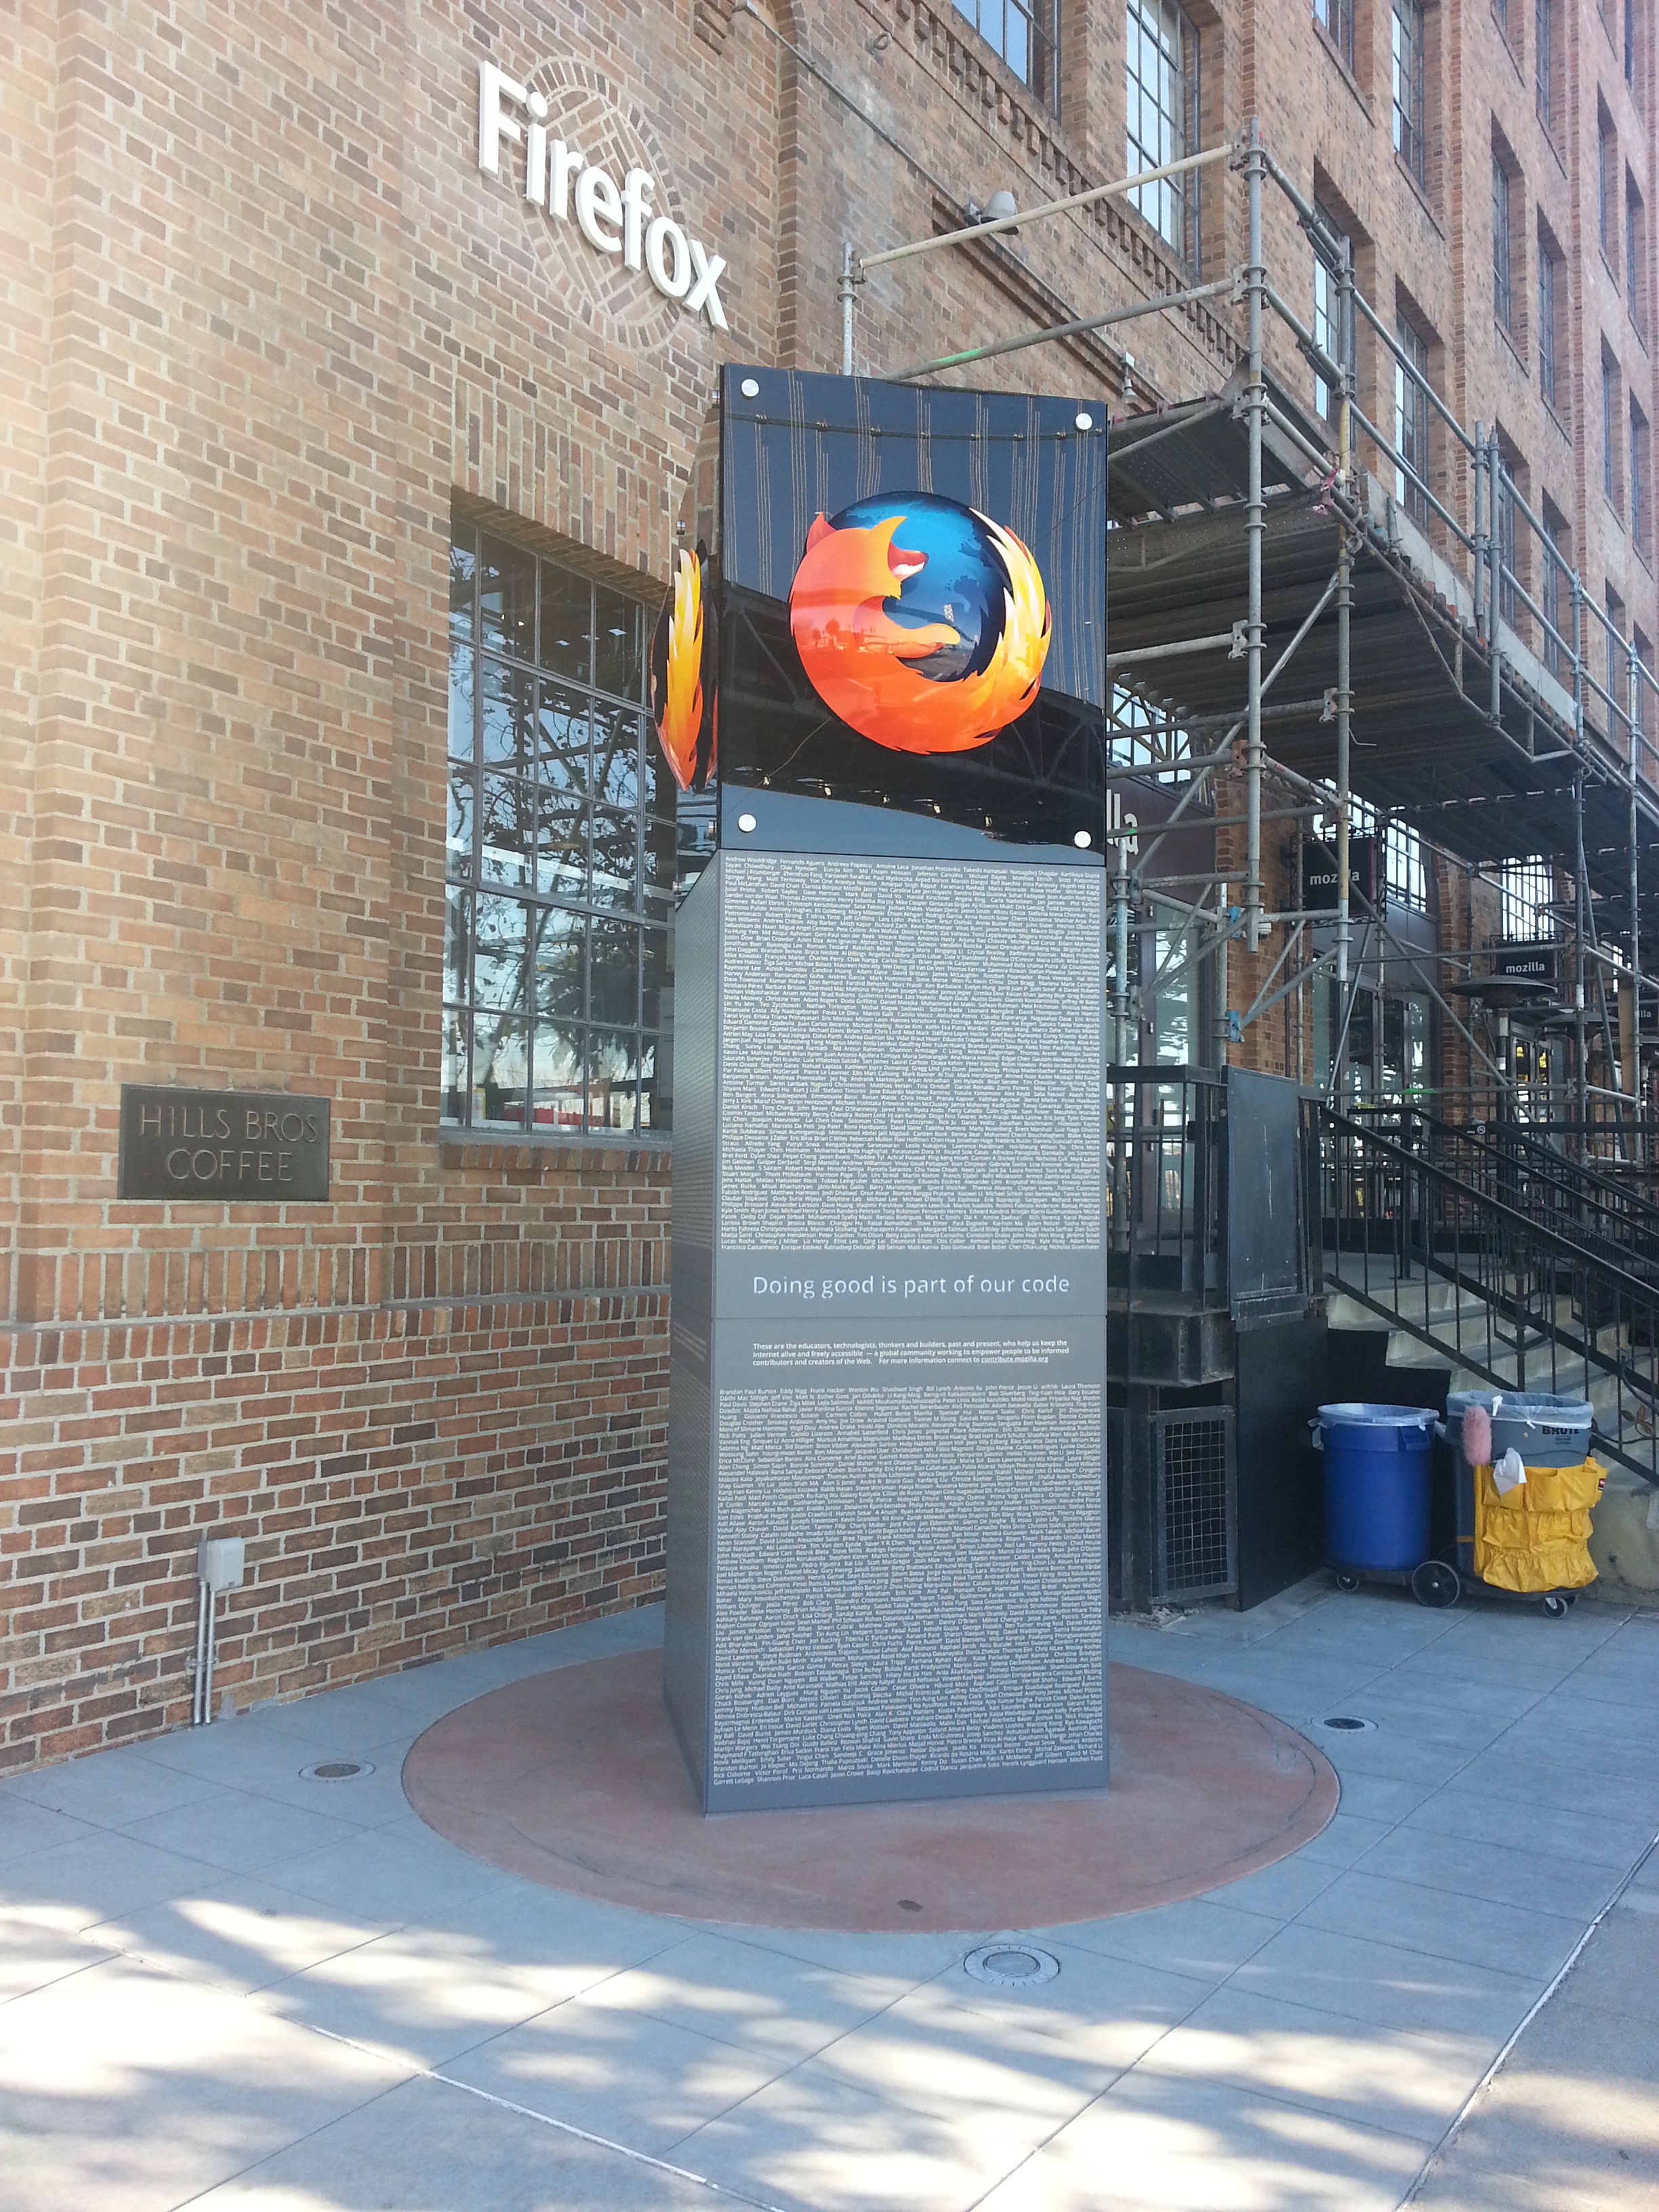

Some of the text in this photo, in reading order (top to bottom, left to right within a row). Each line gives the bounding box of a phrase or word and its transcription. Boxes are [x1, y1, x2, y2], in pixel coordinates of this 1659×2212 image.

[478, 60, 730, 331] Firefox
[1506, 962, 1545, 973] mozilla
[139, 1104, 319, 1143] HILLS BROS
[165, 1148, 293, 1181] COFFEE
[754, 1275, 1069, 1298] Doing good is part of our code
[947, 1341, 962, 1349] past
[1017, 1340, 1031, 1348] help
[1040, 1340, 1056, 1348] keep
[811, 1350, 830, 1359] freely
[879, 1349, 899, 1357] global
[900, 1349, 935, 1357] community
[937, 1349, 962, 1357] working
[1002, 1348, 1023, 1356] people
[981, 1356, 1049, 1365] contribute.mozilla.org
